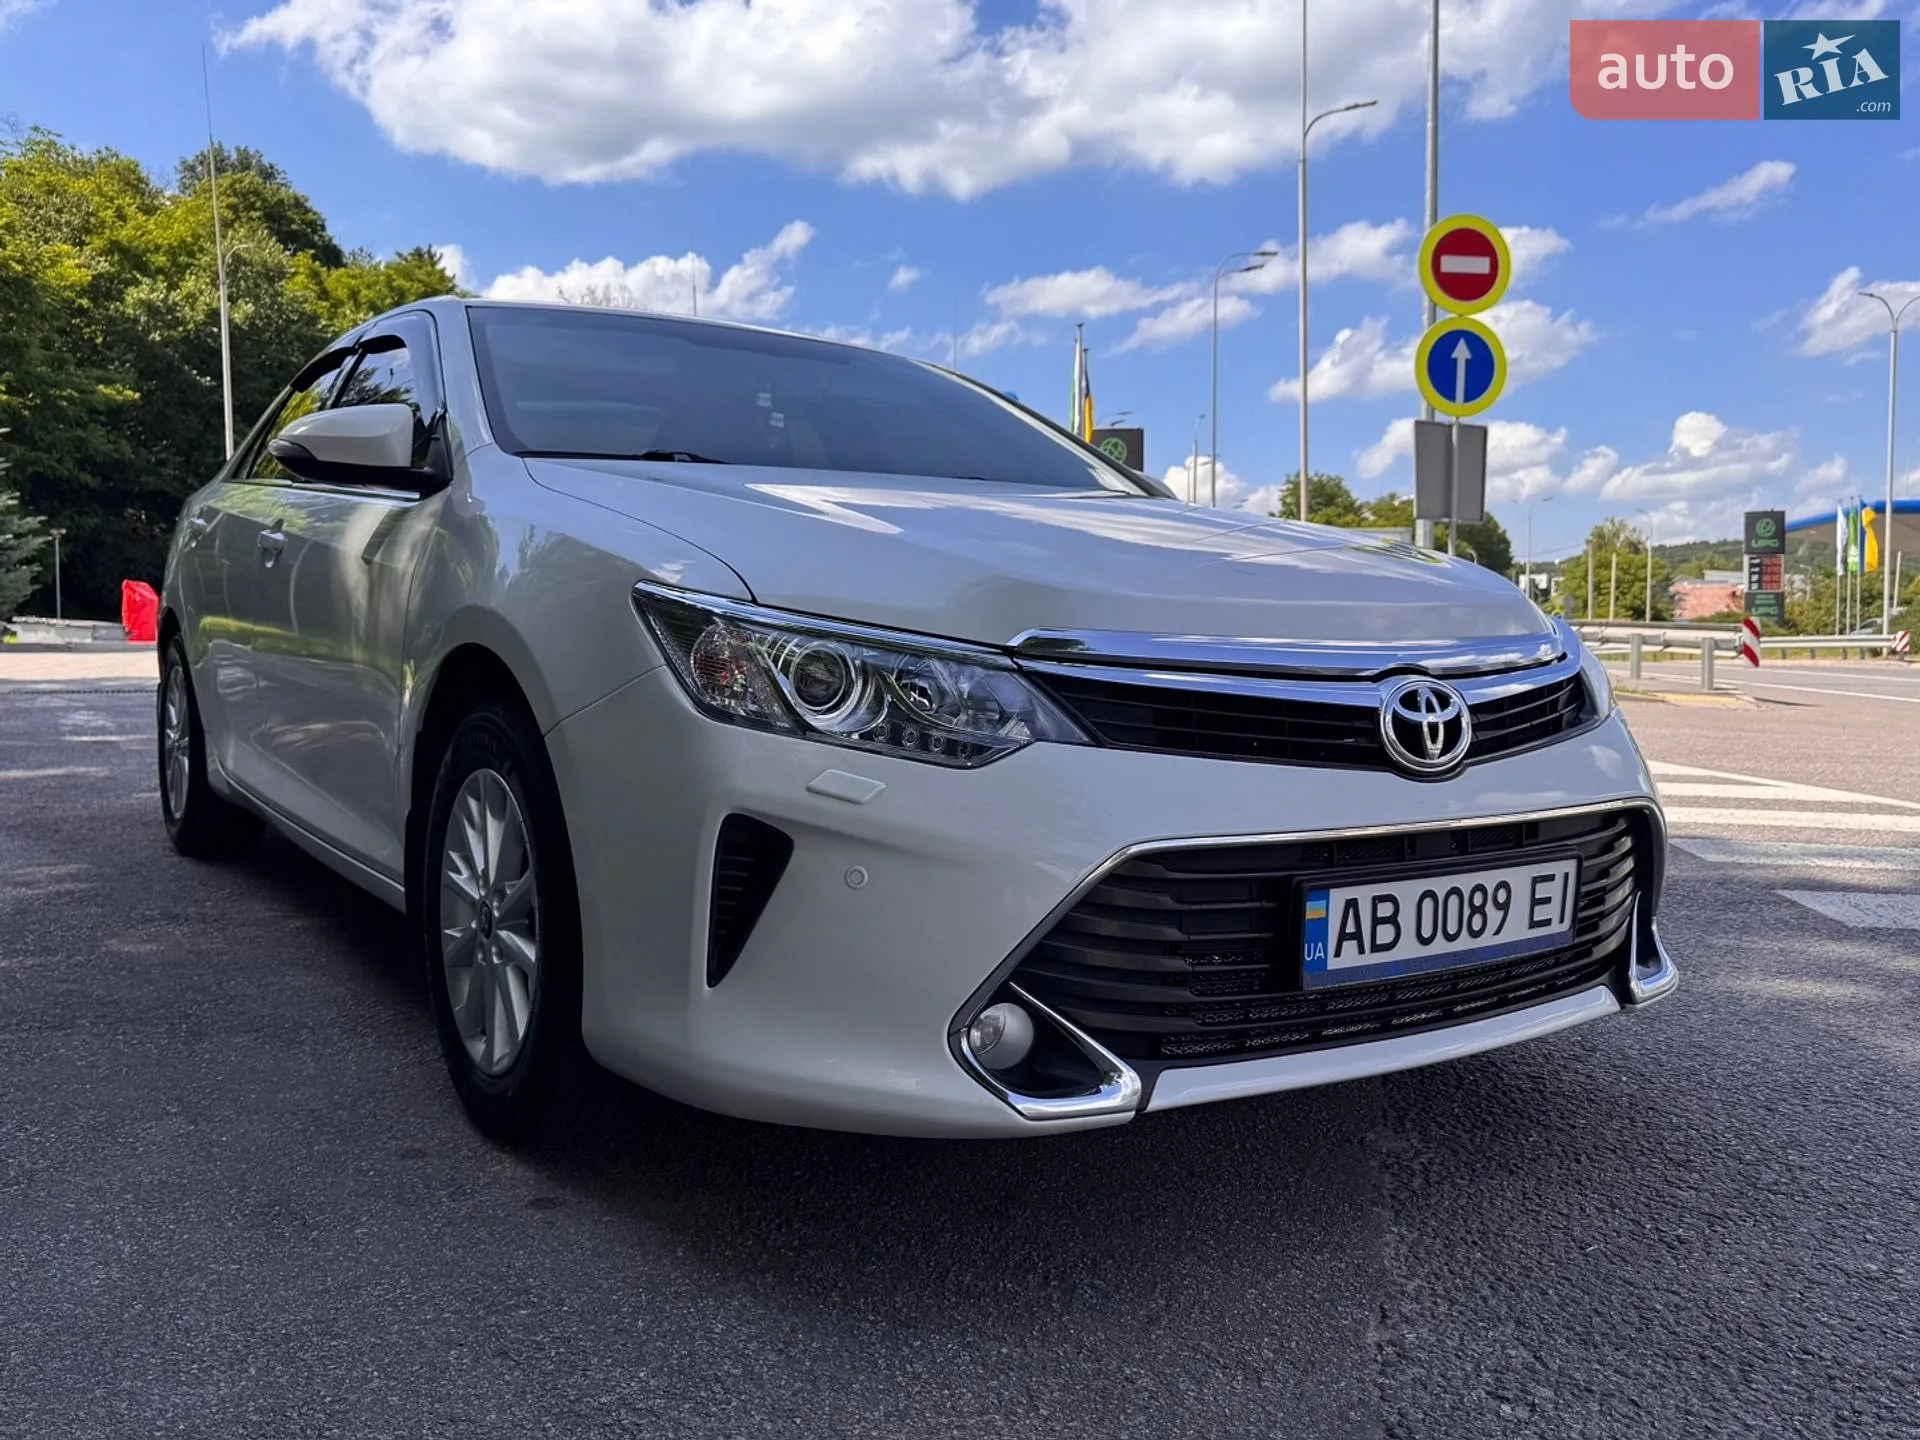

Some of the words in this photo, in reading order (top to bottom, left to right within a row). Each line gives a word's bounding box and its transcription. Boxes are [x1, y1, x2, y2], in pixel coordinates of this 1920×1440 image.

[1334, 893, 1401, 958] AB
[1415, 880, 1512, 946] 0089
[1528, 872, 1569, 929] EI
[1304, 942, 1325, 961] UA
